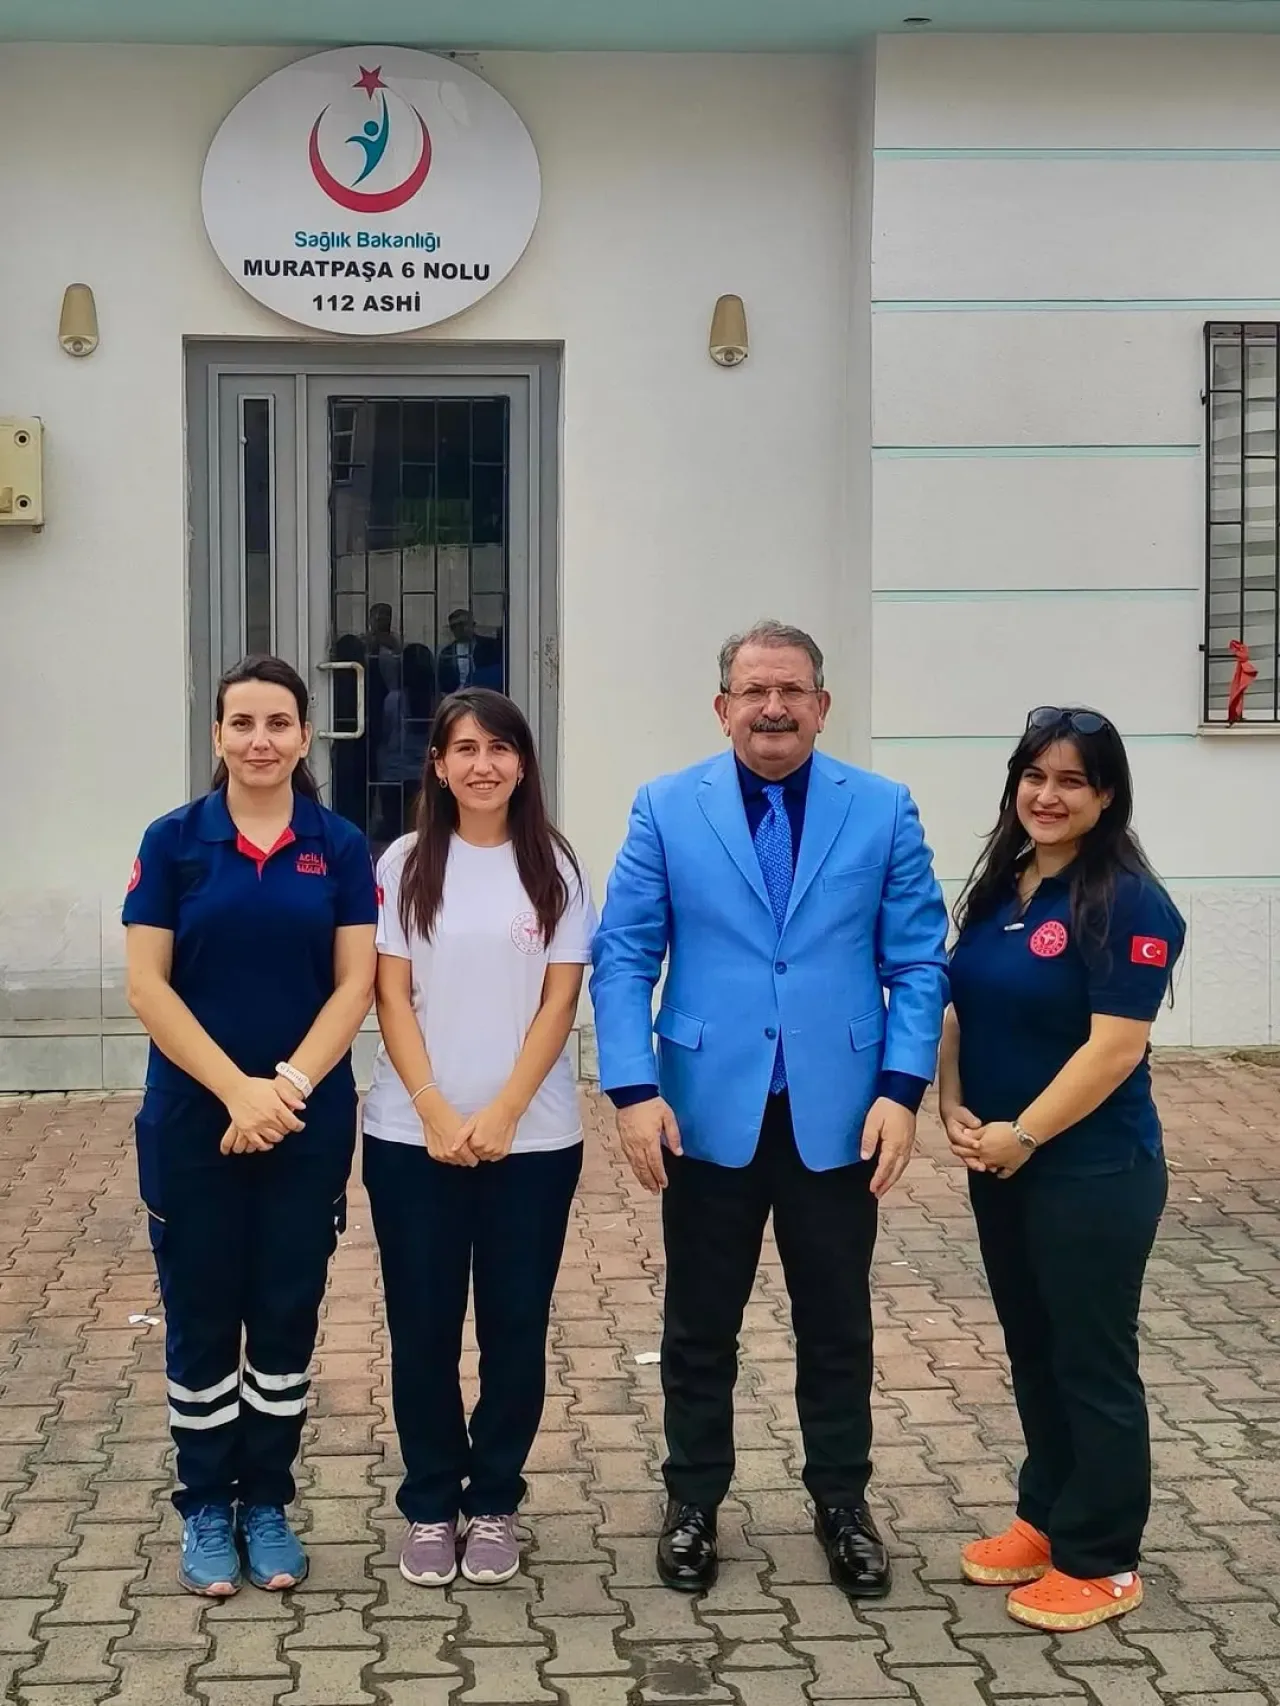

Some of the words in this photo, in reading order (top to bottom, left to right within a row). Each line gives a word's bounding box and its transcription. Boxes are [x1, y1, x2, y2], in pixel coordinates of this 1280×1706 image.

[295, 231, 351, 252] Sağlık
[356, 231, 441, 253] Bakanlığı
[243, 259, 394, 283] MURATPAŞA
[401, 261, 416, 279] 6
[423, 262, 490, 281] NOLU
[312, 294, 355, 312] 112
[362, 291, 421, 312] ASHİ
